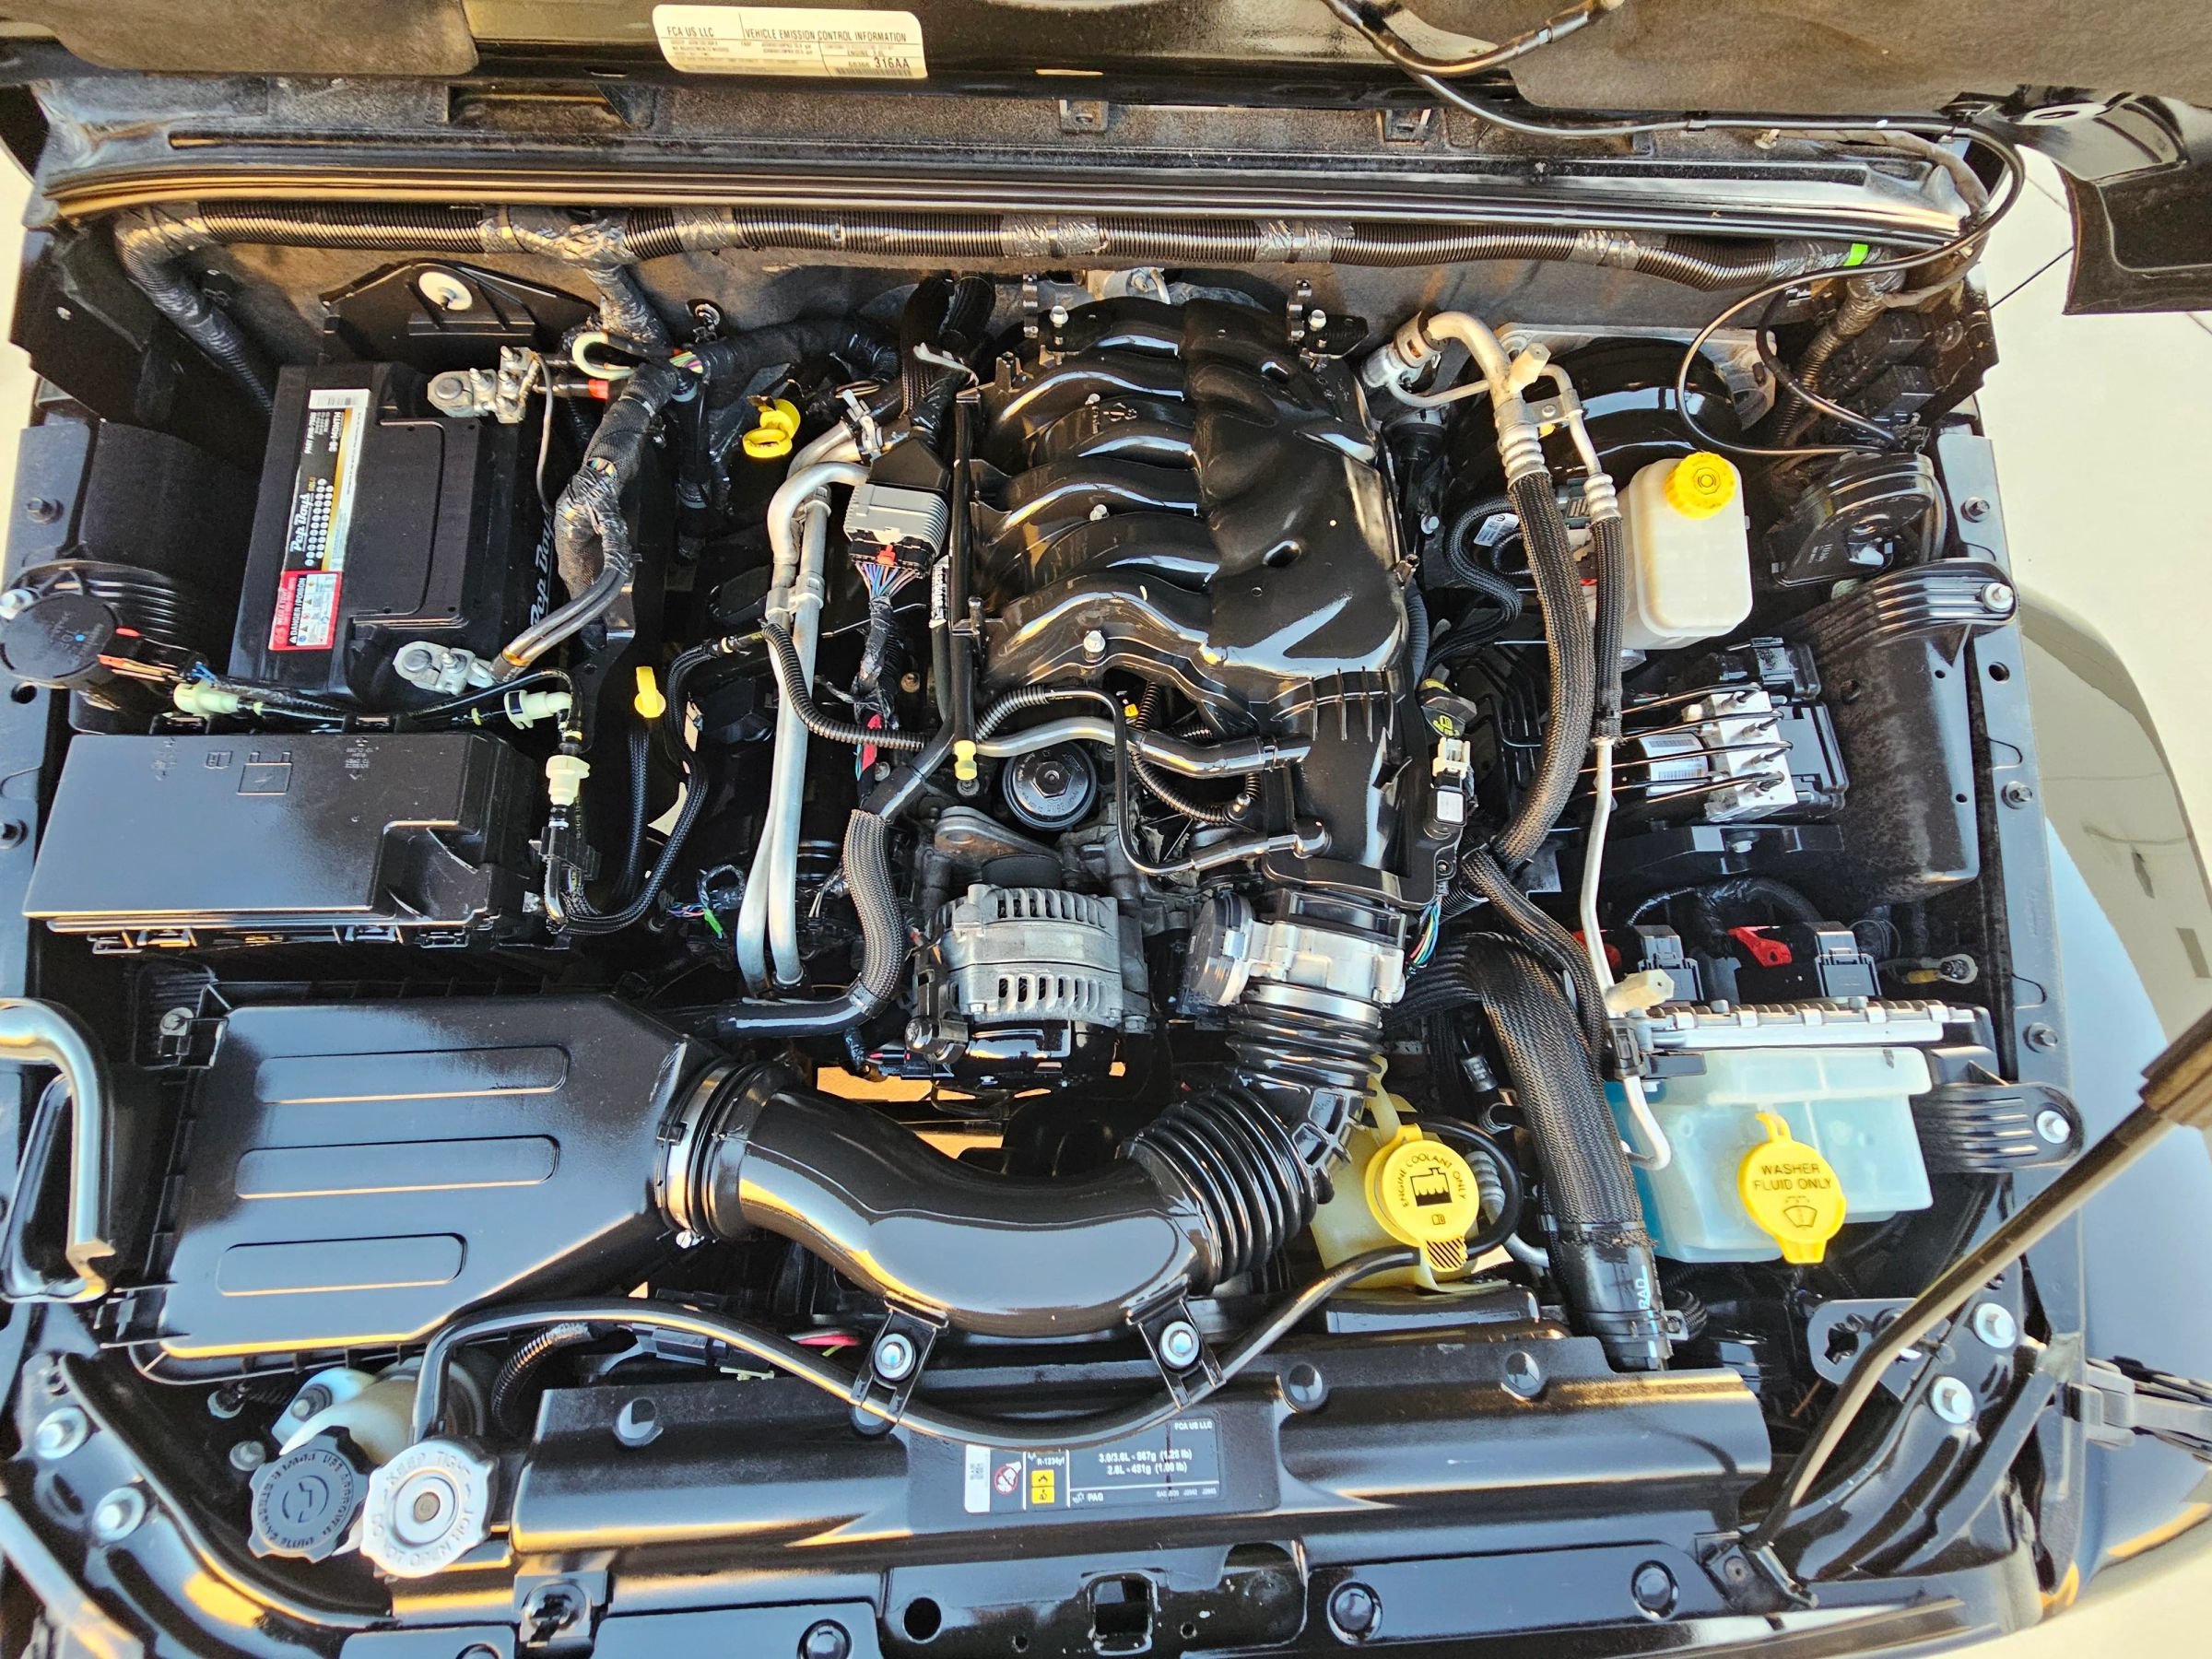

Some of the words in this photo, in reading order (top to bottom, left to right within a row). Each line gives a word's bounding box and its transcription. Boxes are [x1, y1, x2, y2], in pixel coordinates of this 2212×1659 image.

[666, 26, 683, 37] FCA
[685, 27, 697, 37] US
[699, 27, 714, 38] LLC
[745, 29, 777, 40] VEHICLE
[779, 29, 816, 41] EMISSION
[818, 30, 853, 41] CONTROL
[854, 31, 907, 42] INFORMATION
[874, 56, 911, 69] 316AA
[294, 492, 314, 526] Boys
[289, 524, 309, 553] Pep
[531, 579, 549, 626] Pep
[289, 606, 302, 636] DANGER
[1761, 1163, 1820, 1175] WASHER
[1397, 1168, 1409, 1208] ENGINE
[1406, 1153, 1453, 1169] COOLANT
[1452, 1171, 1467, 1200] ONLY
[1753, 1179, 1793, 1191] FLUID
[1797, 1177, 1832, 1190] ONLY
[1174, 1422, 1189, 1430] FCA
